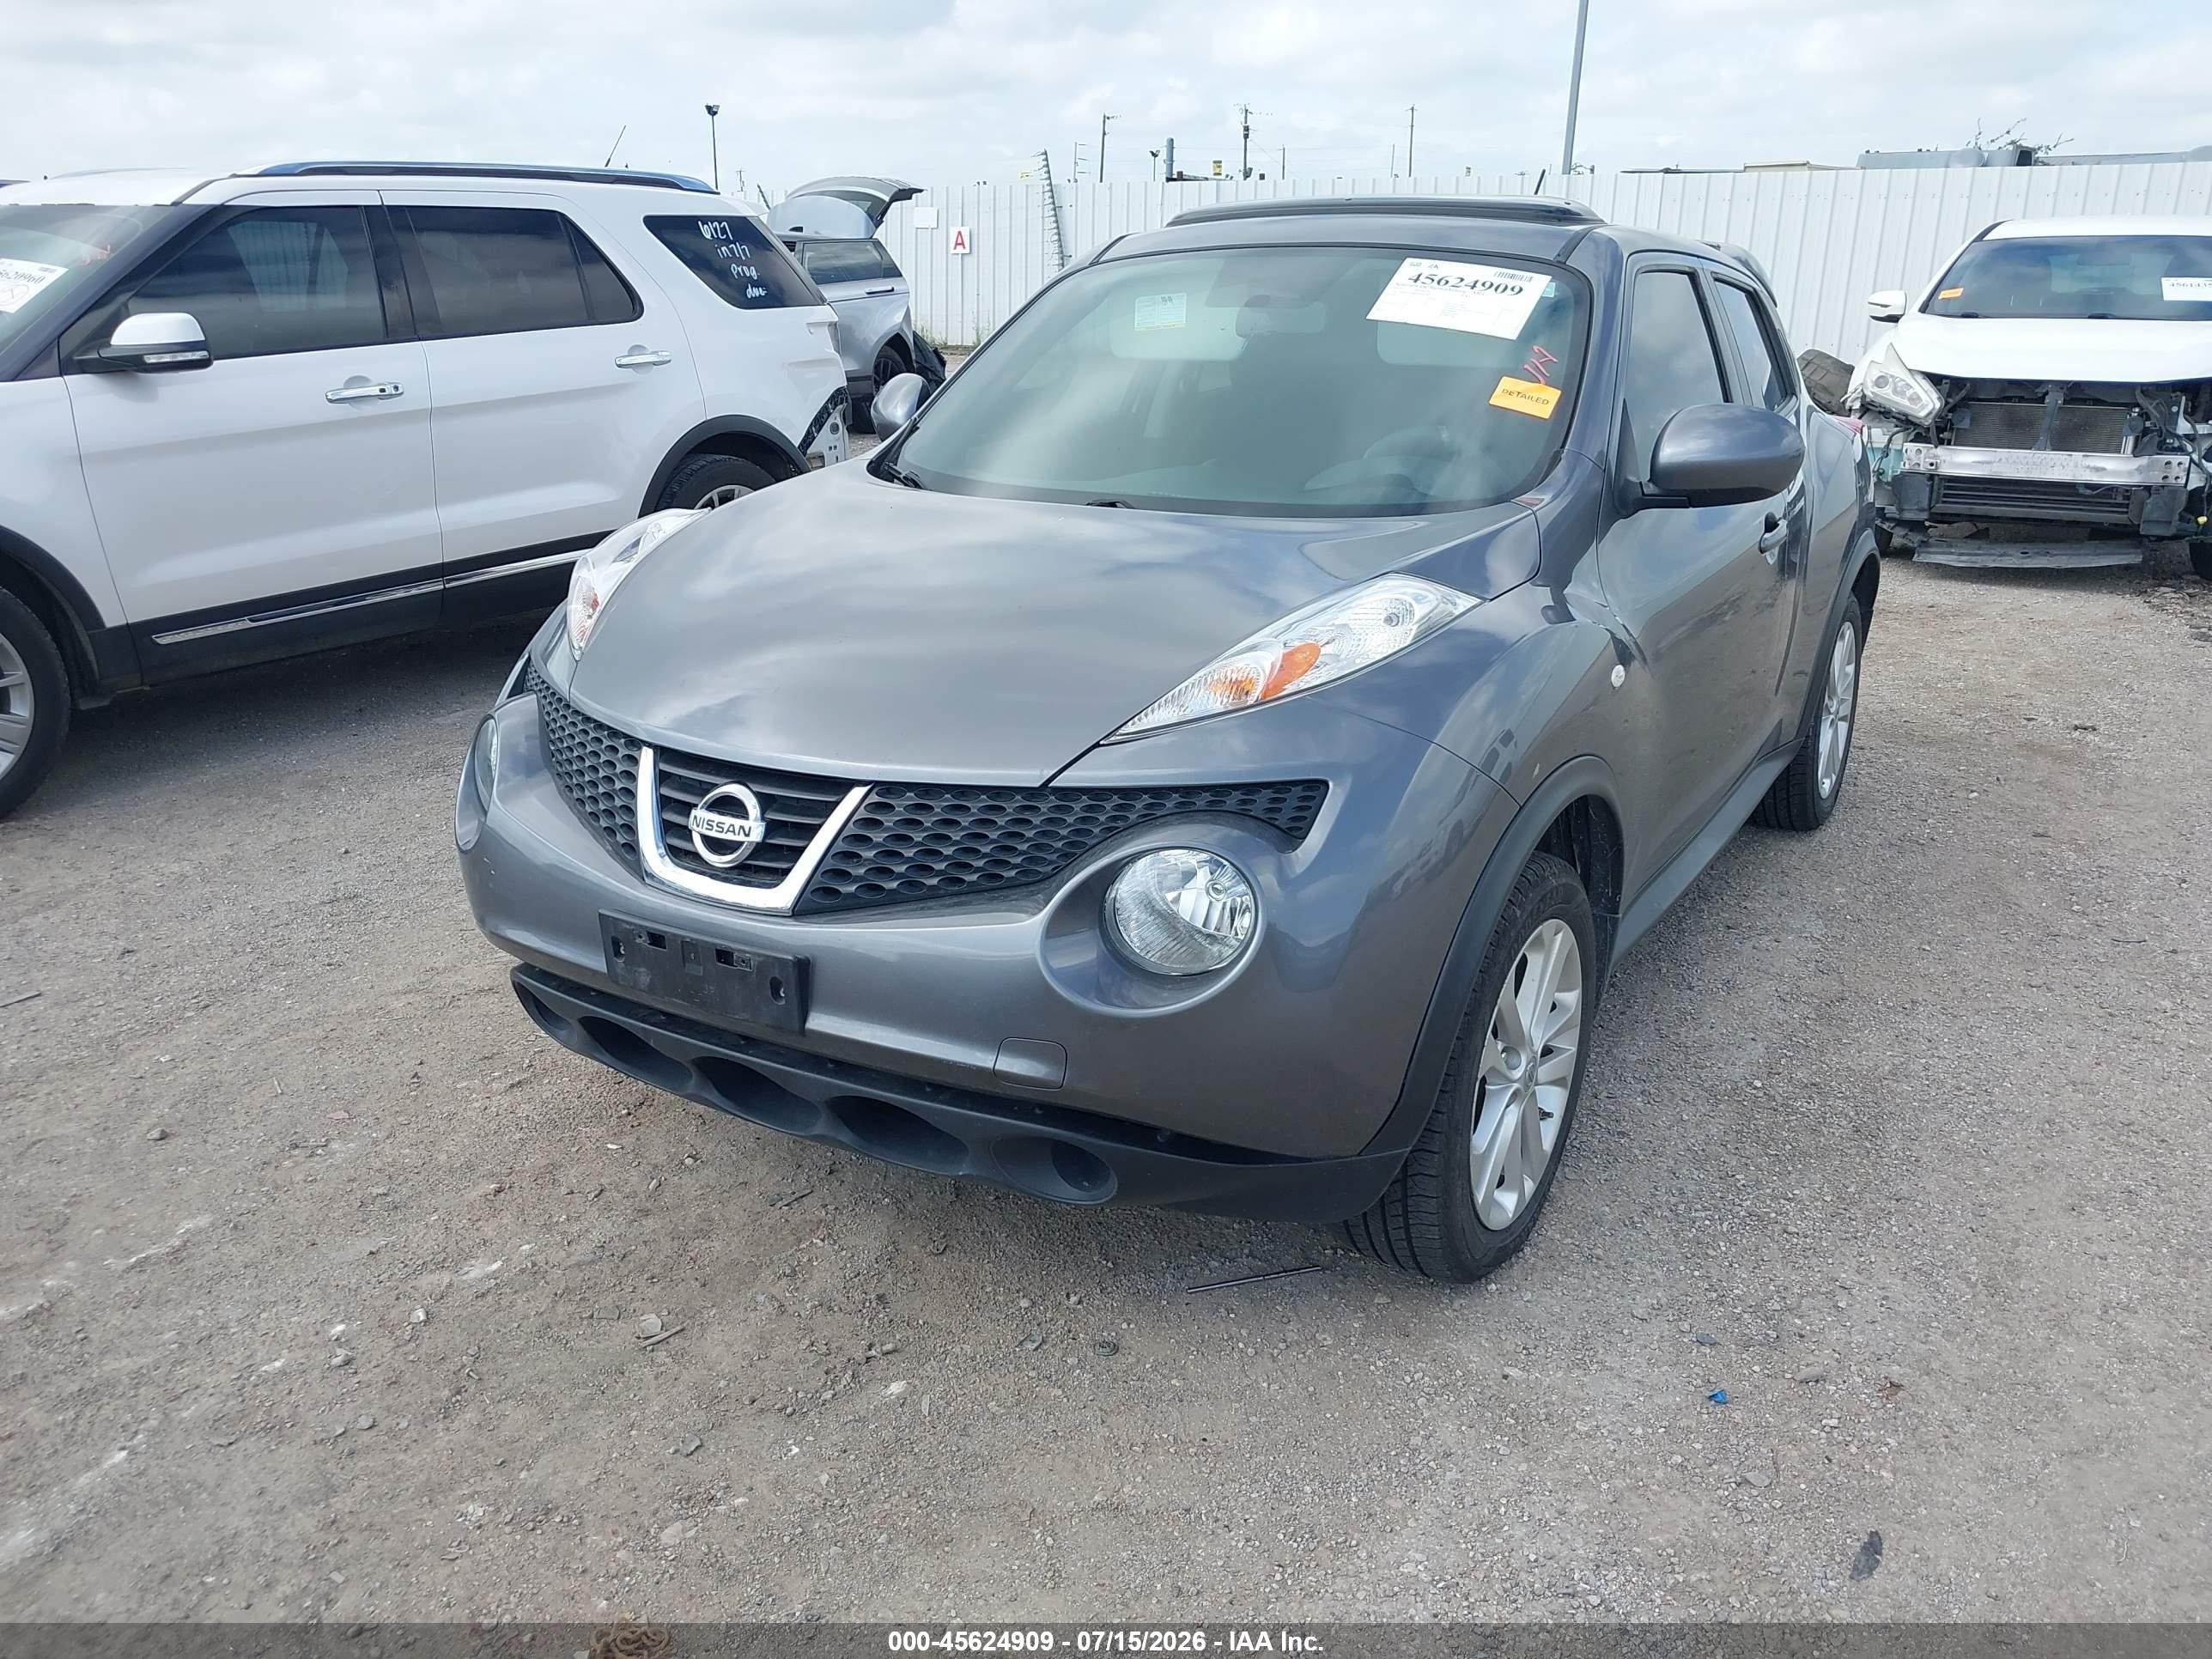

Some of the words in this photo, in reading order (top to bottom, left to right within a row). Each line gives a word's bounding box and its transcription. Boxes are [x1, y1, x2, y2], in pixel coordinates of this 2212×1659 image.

[952, 230, 967, 251] A
[1407, 271, 1524, 296] 45624909
[1501, 388, 1550, 405] DETAILED
[691, 814, 752, 838] NISSAN
